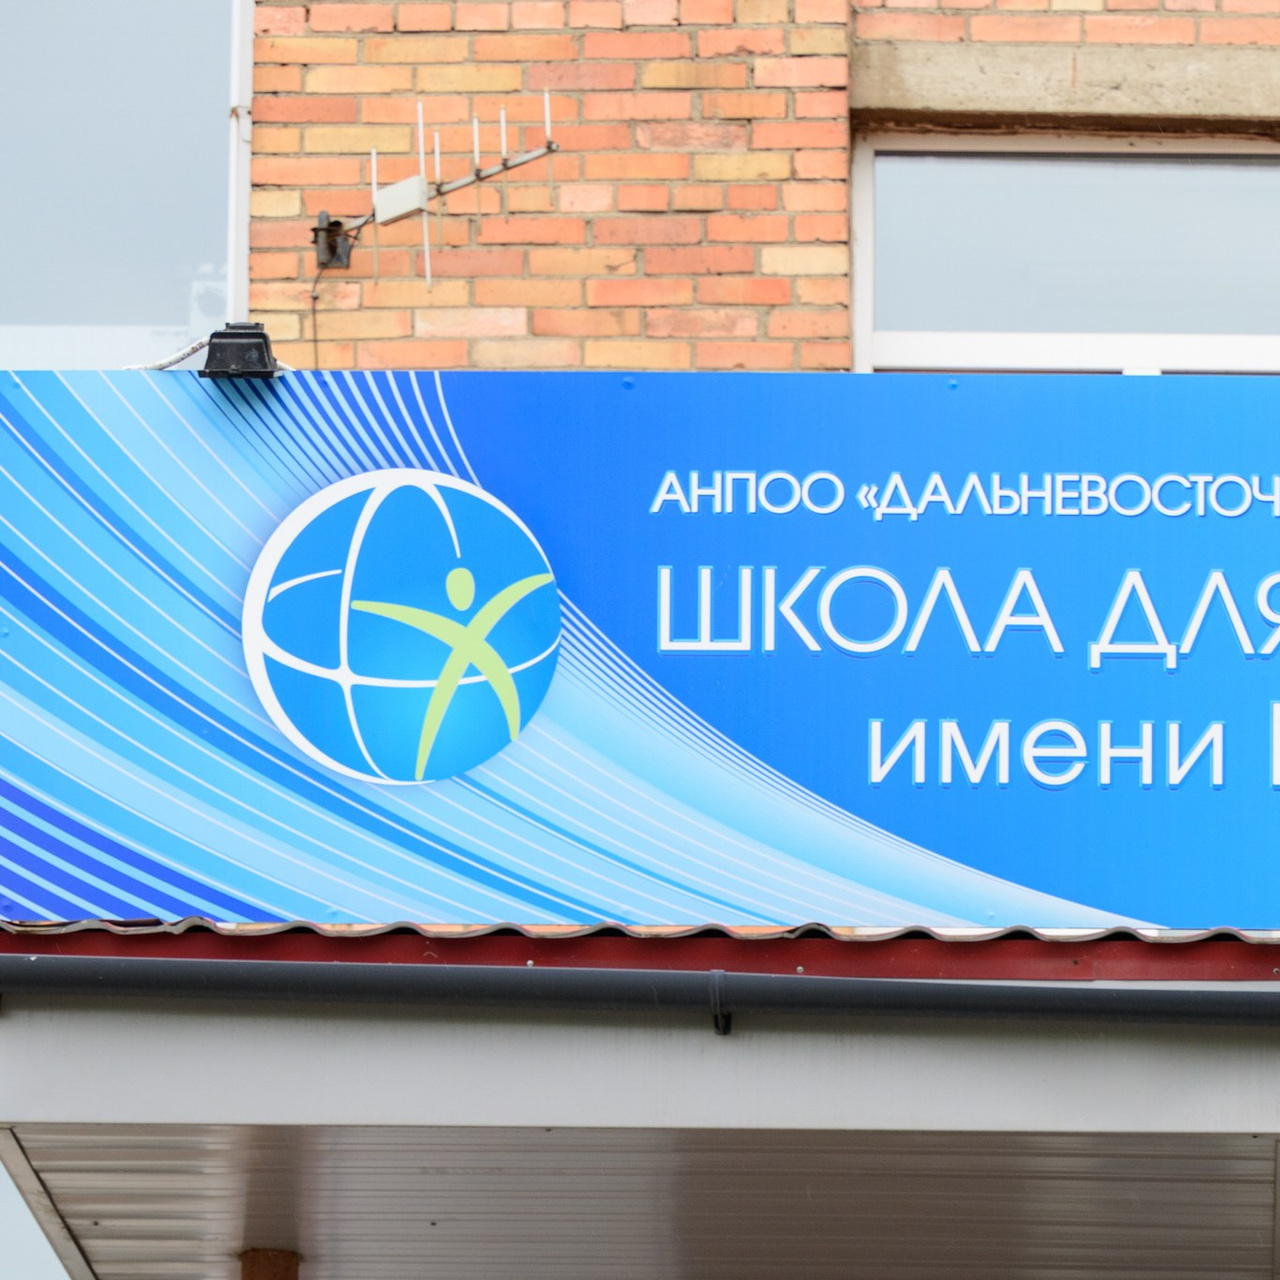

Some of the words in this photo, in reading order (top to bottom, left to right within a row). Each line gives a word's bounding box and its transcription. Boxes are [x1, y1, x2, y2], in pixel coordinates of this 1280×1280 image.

[652, 472, 845, 514] АНПОО
[657, 566, 1065, 656] ШКОЛА
[870, 718, 1224, 786] имени
